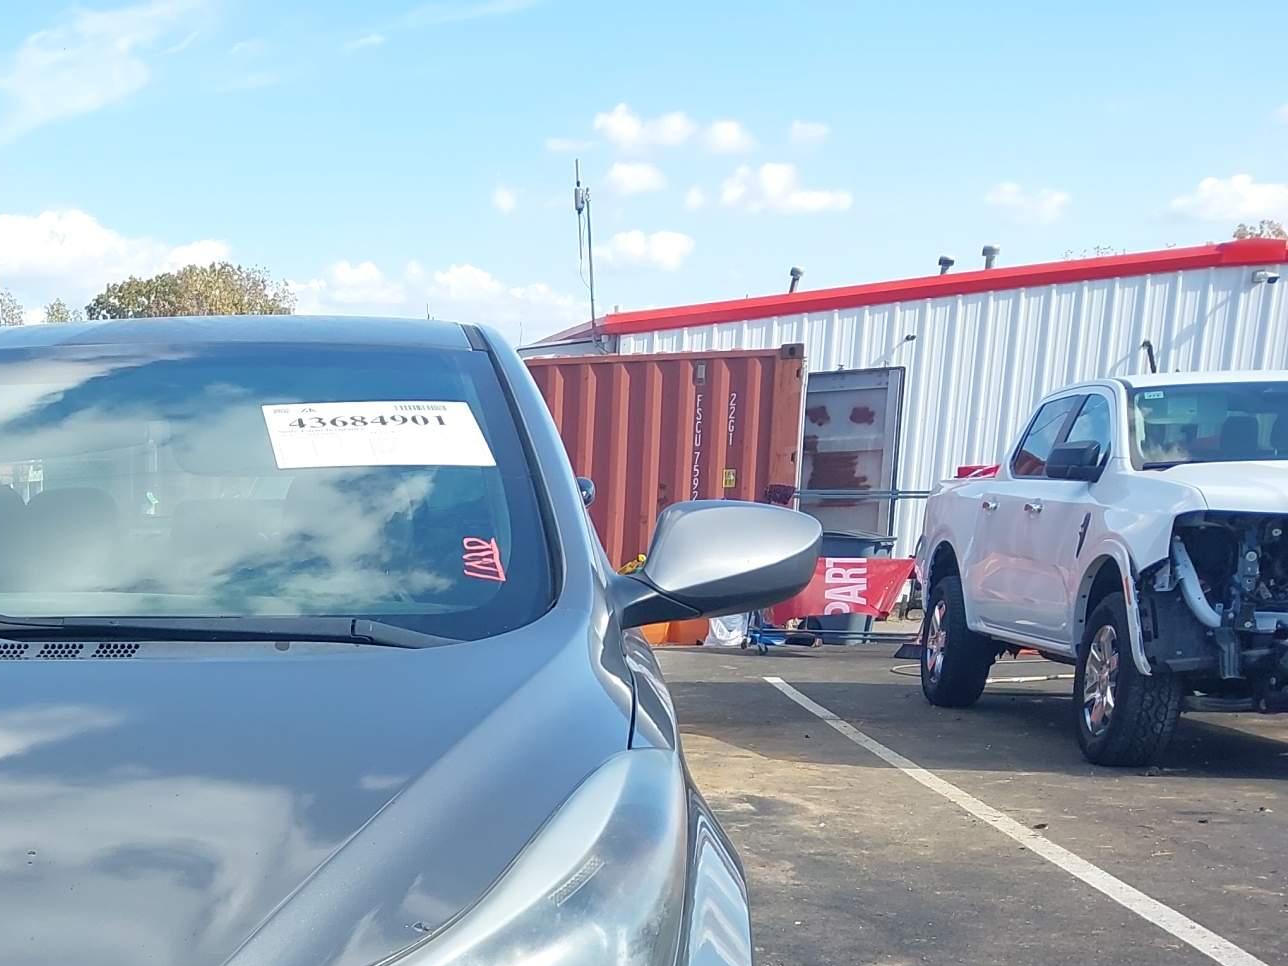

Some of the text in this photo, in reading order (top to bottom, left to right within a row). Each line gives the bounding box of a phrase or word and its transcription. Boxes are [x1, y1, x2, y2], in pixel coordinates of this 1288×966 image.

[289, 415, 447, 429] 43684901
[694, 394, 703, 447] FSCU
[728, 393, 737, 446] 22G1
